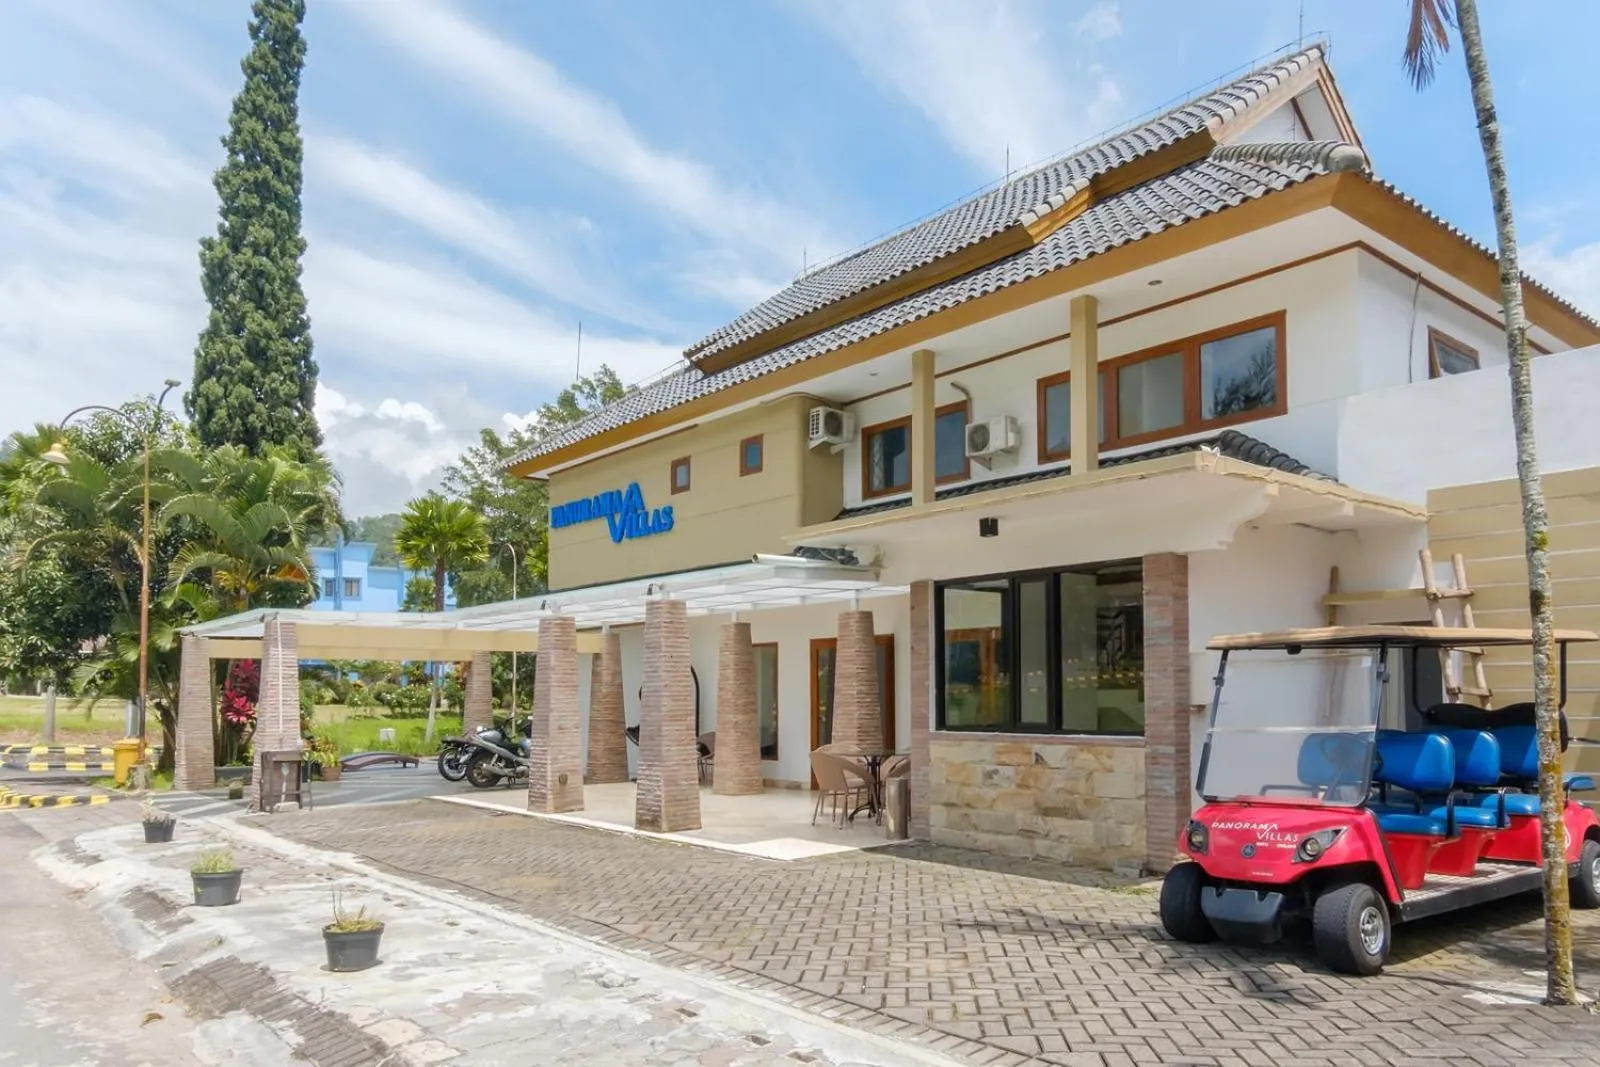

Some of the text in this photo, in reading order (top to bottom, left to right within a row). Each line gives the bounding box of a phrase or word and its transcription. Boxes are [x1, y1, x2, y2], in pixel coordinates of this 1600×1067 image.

[607, 504, 674, 544] VILLAS
[1211, 821, 1278, 831] PANORAMA
[1256, 830, 1299, 842] VILLAS
